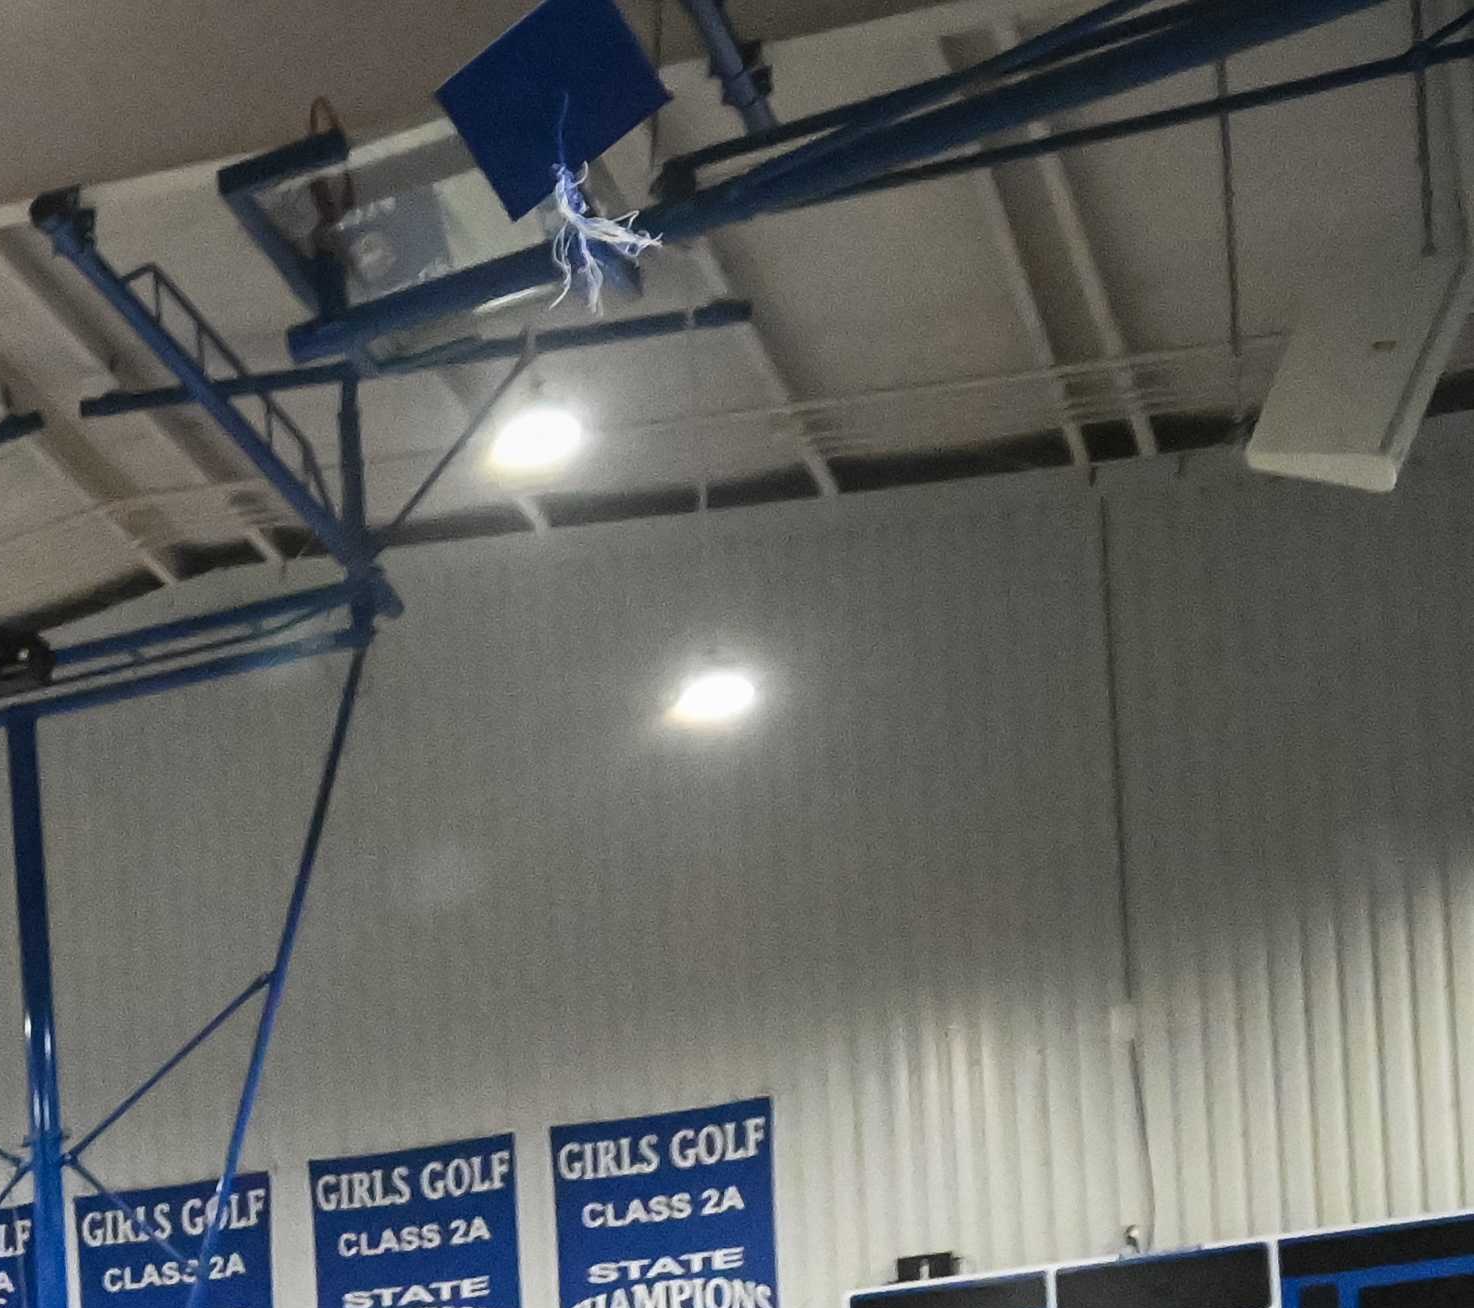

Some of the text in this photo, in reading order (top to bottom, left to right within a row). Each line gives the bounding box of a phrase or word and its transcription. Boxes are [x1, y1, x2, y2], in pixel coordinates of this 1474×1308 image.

[558, 1117, 766, 1180] GIRLS GOLF
[316, 1150, 511, 1211] GIRLS GOLF
[582, 1186, 744, 1229] CLASS 2A
[338, 1216, 491, 1257] CLASS 2A
[588, 1247, 744, 1284] STATE
